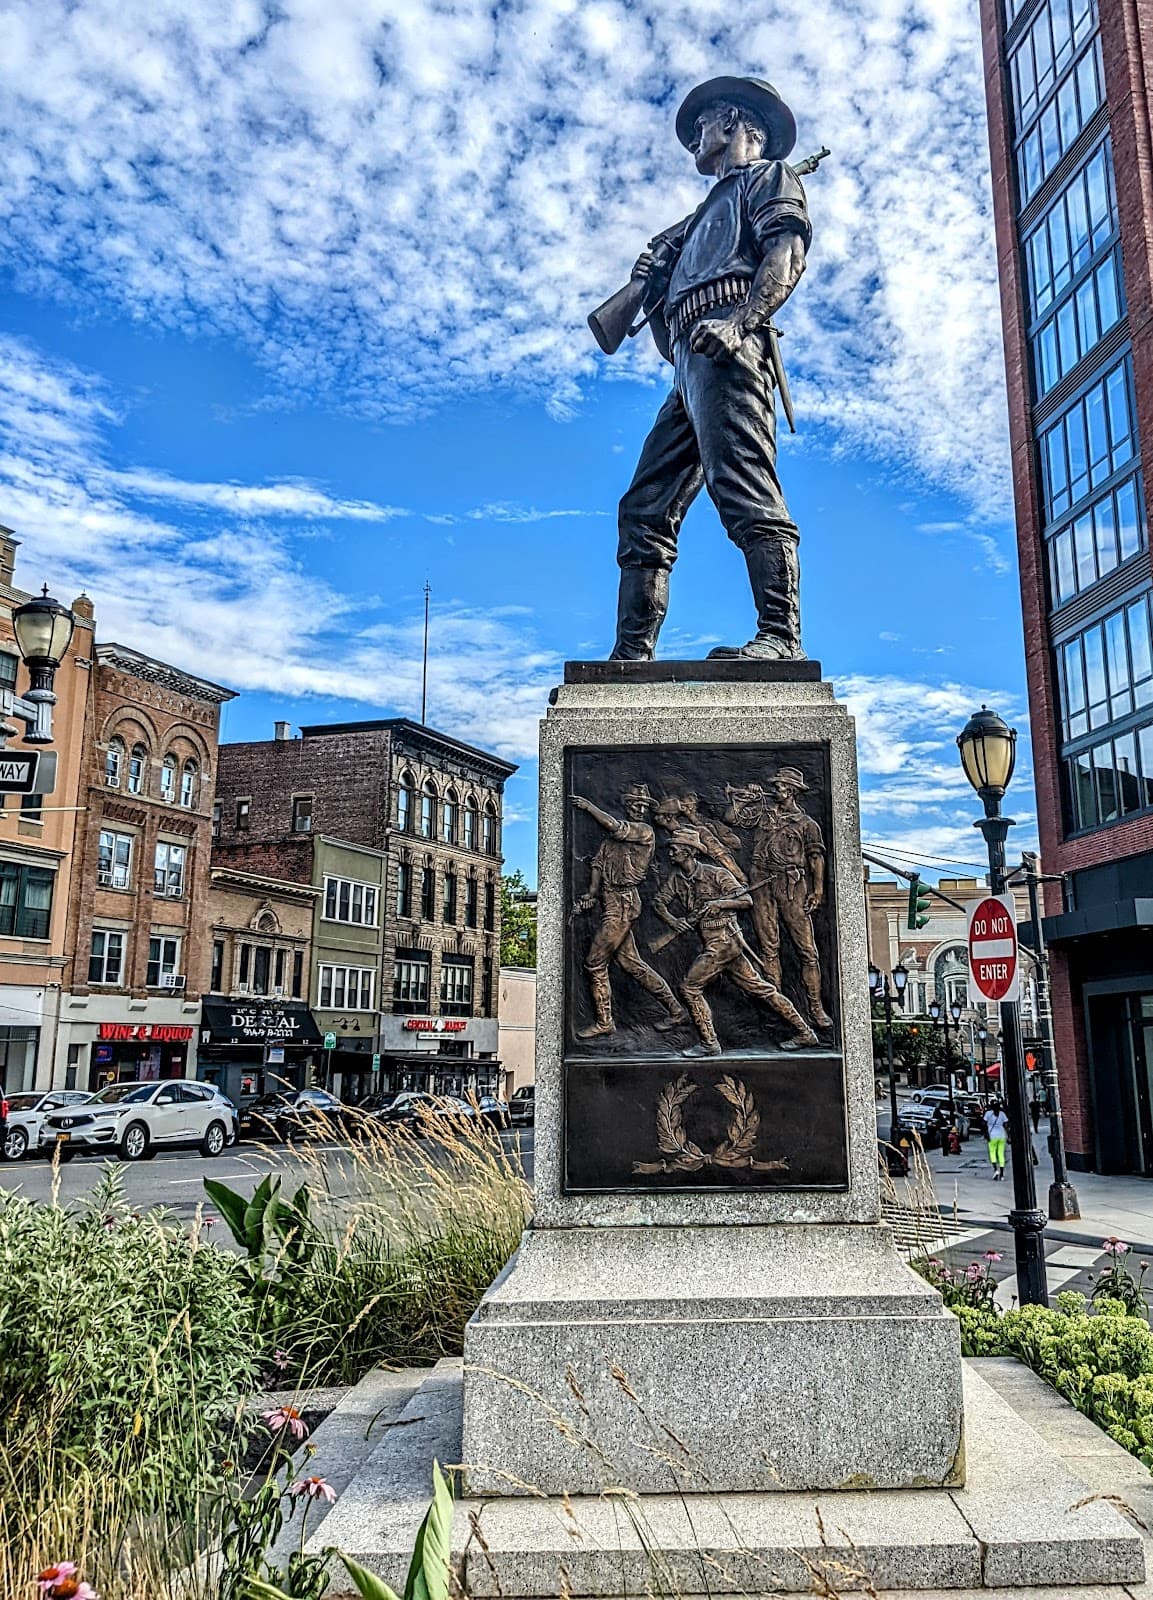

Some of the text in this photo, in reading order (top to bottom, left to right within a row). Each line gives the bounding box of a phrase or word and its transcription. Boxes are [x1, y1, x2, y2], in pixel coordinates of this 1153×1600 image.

[974, 917, 1008, 935] DO NOT
[980, 963, 1008, 980] ENTER
[231, 1014, 300, 1029] DEAL
[101, 1023, 135, 1040] WINE
[137, 1025, 148, 1040] &
